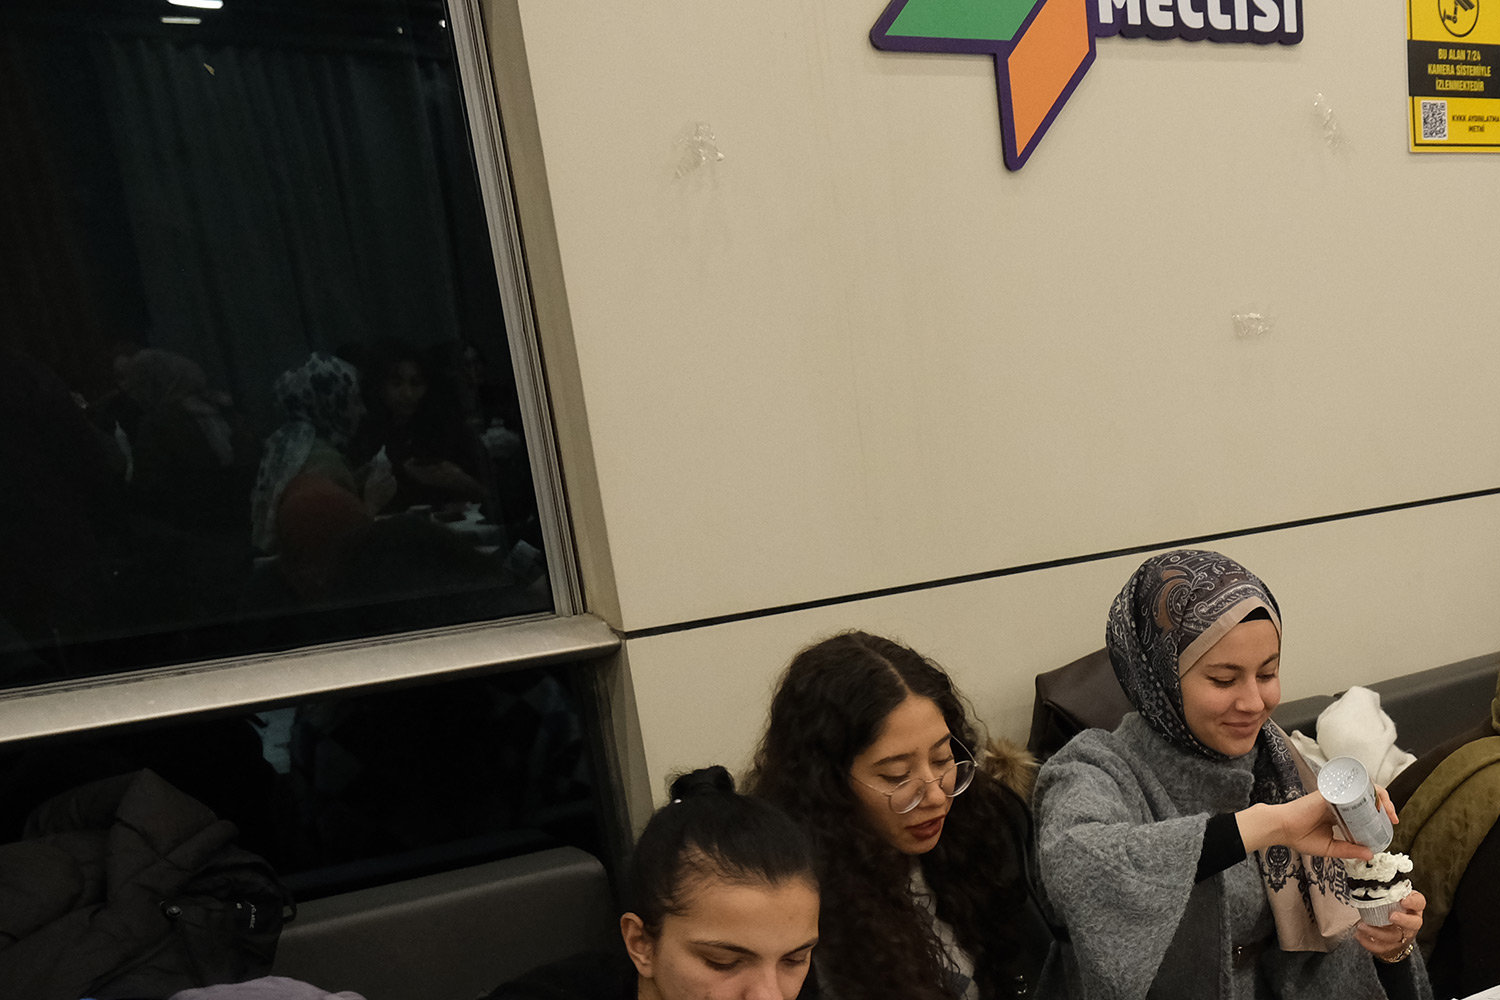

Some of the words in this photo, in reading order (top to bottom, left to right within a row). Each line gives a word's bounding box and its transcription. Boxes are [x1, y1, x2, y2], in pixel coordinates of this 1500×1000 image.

[1437, 48, 1448, 60] BU
[1448, 48, 1466, 61] ALAN
[1466, 49, 1482, 62] 7/24
[1427, 63, 1455, 76] KAMERA
